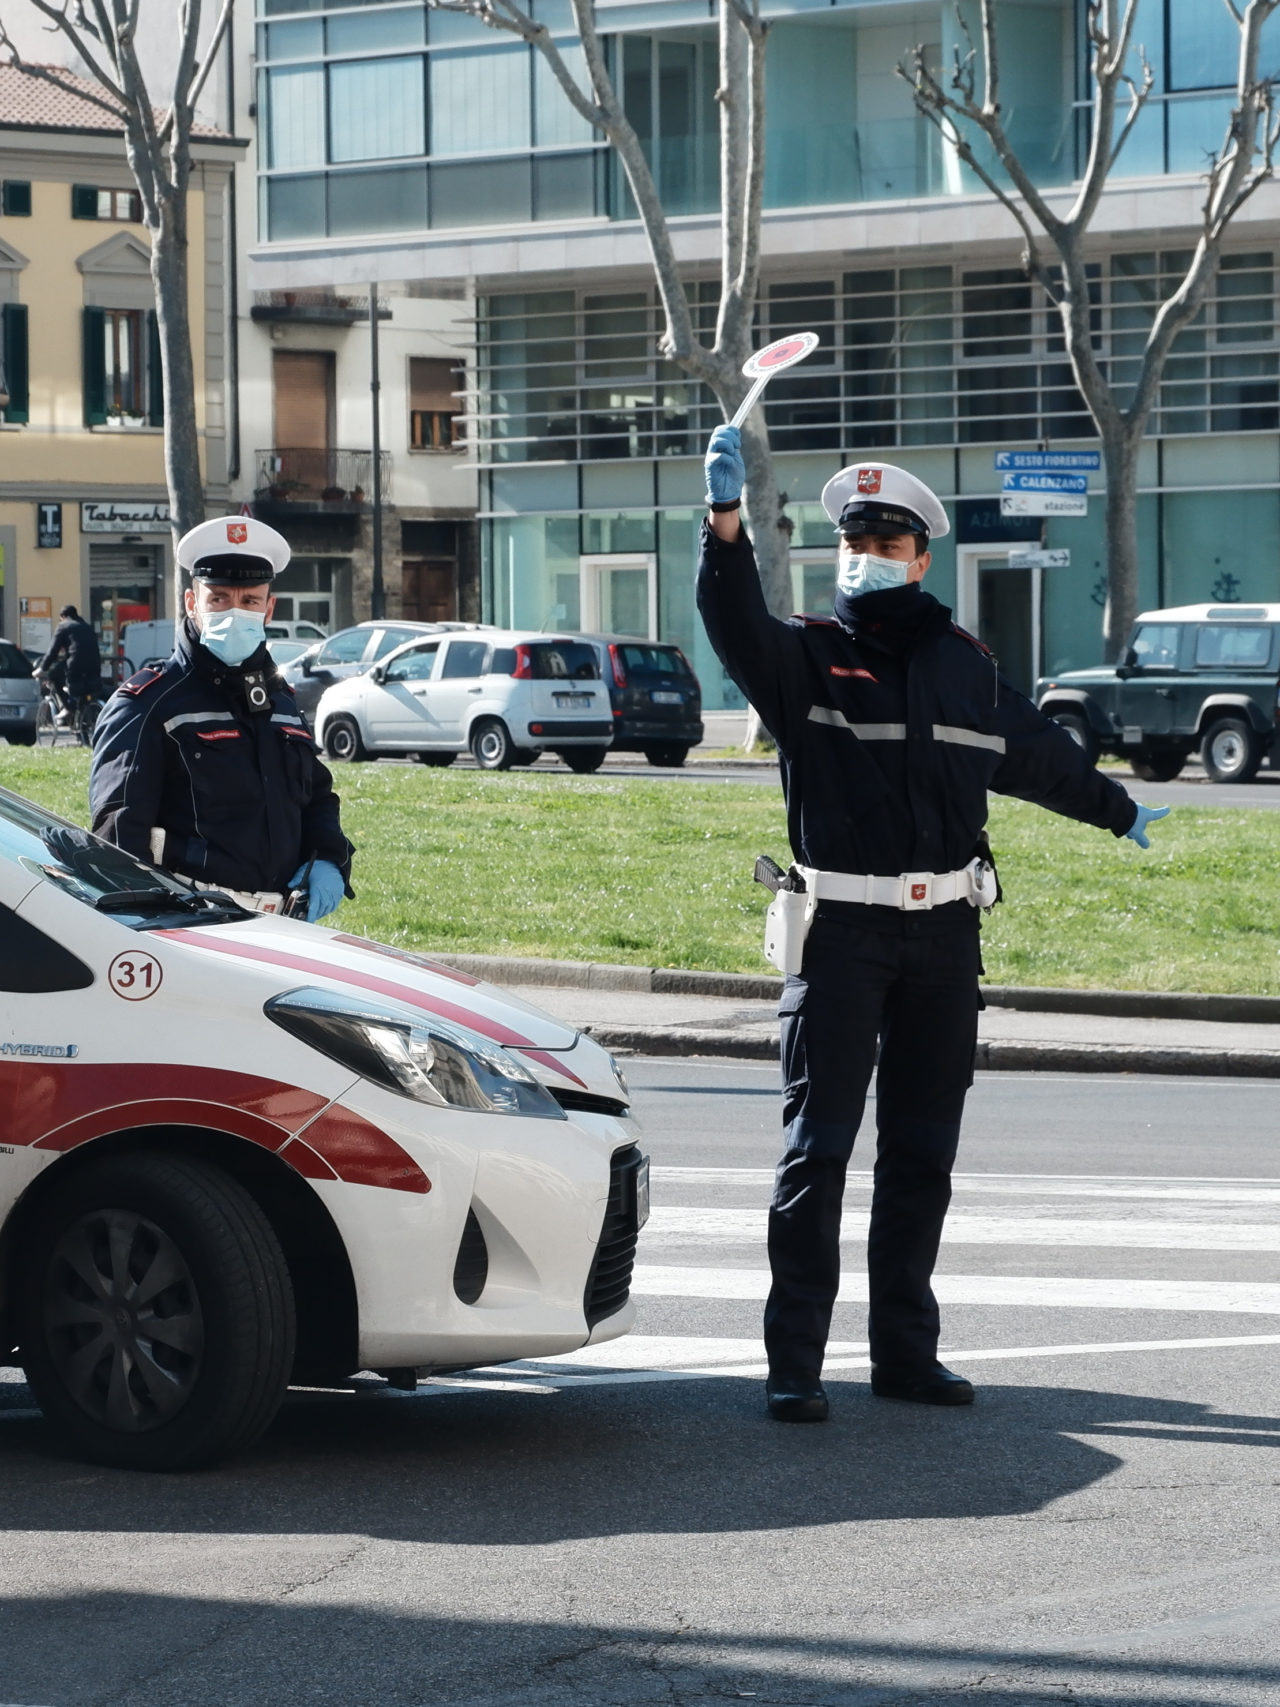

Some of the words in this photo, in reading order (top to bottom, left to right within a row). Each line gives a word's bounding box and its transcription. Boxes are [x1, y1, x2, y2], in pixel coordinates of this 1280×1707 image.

[1014, 455, 1043, 466] SESTO
[1045, 455, 1099, 466] FIORENTINO
[1020, 476, 1086, 489] CALENZANO
[1044, 500, 1085, 511] stazione
[41, 505, 58, 532] T
[84, 505, 171, 521] Tabacchi
[117, 961, 153, 988] 31
